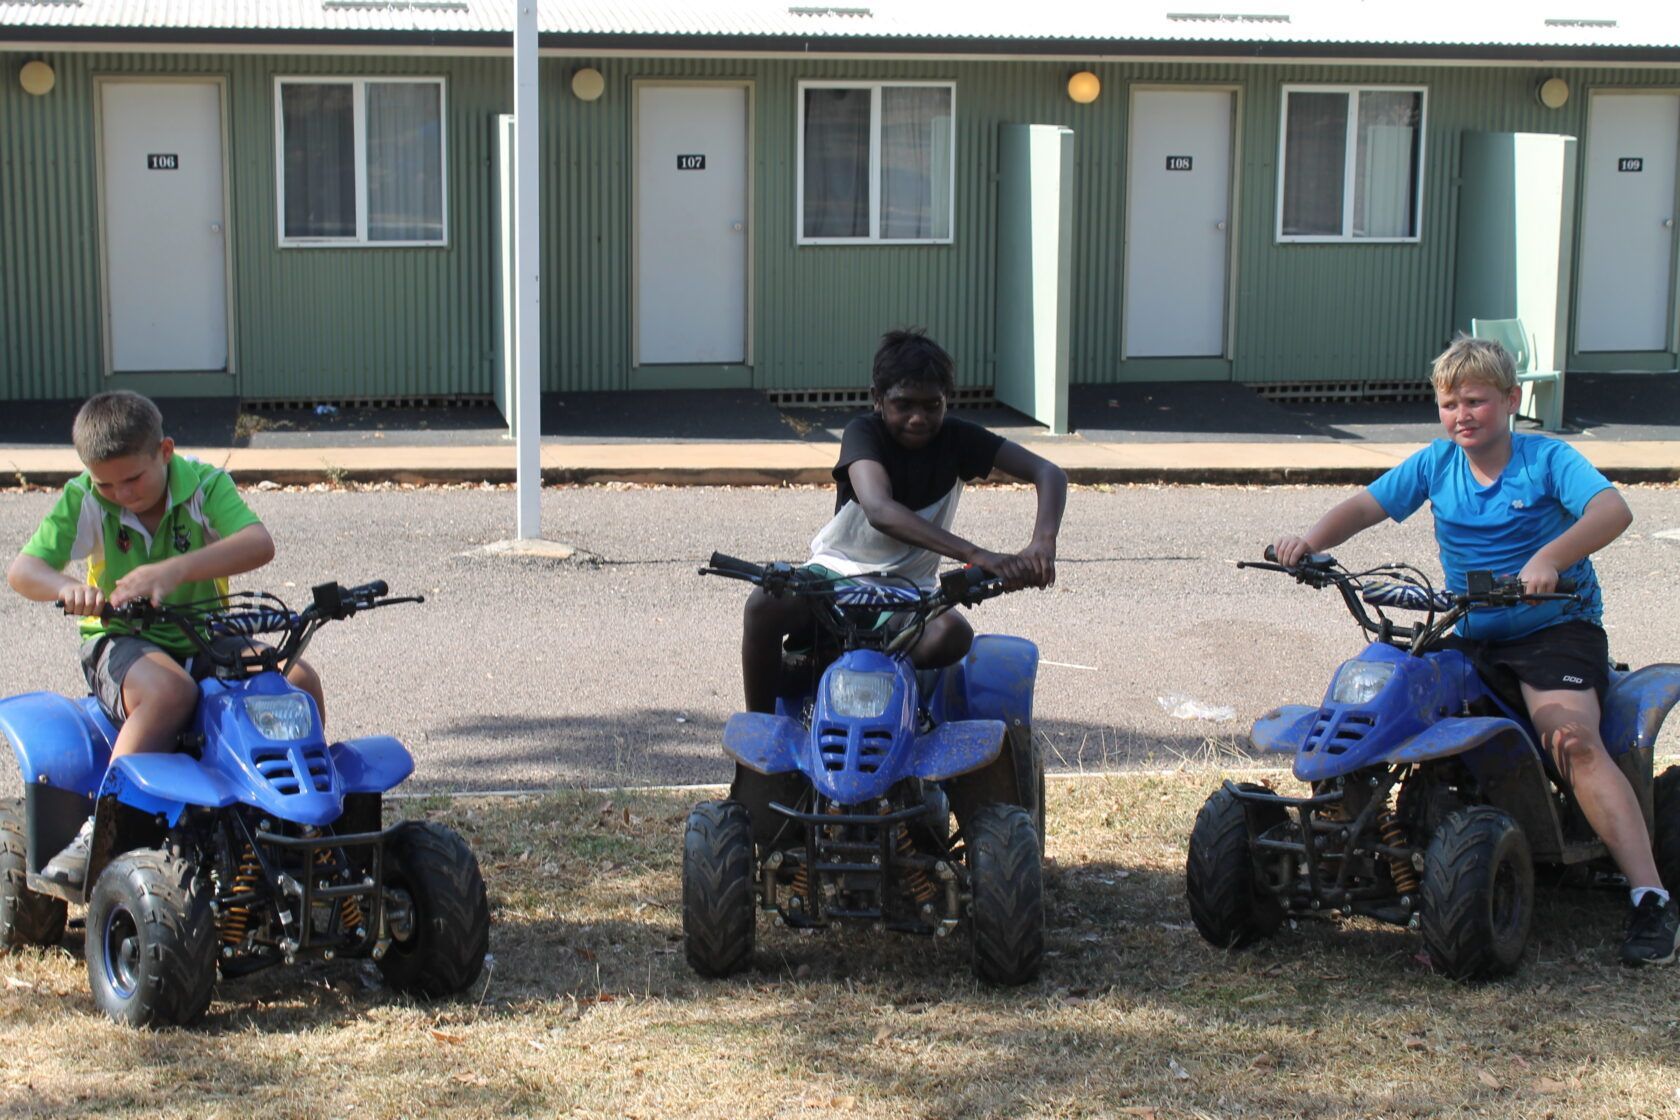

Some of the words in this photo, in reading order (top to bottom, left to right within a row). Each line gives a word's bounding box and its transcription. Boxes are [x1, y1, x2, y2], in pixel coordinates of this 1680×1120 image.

[152, 156, 174, 168] 106
[682, 156, 702, 168] 107
[1170, 158, 1189, 169] 108
[1622, 160, 1640, 170] 109
